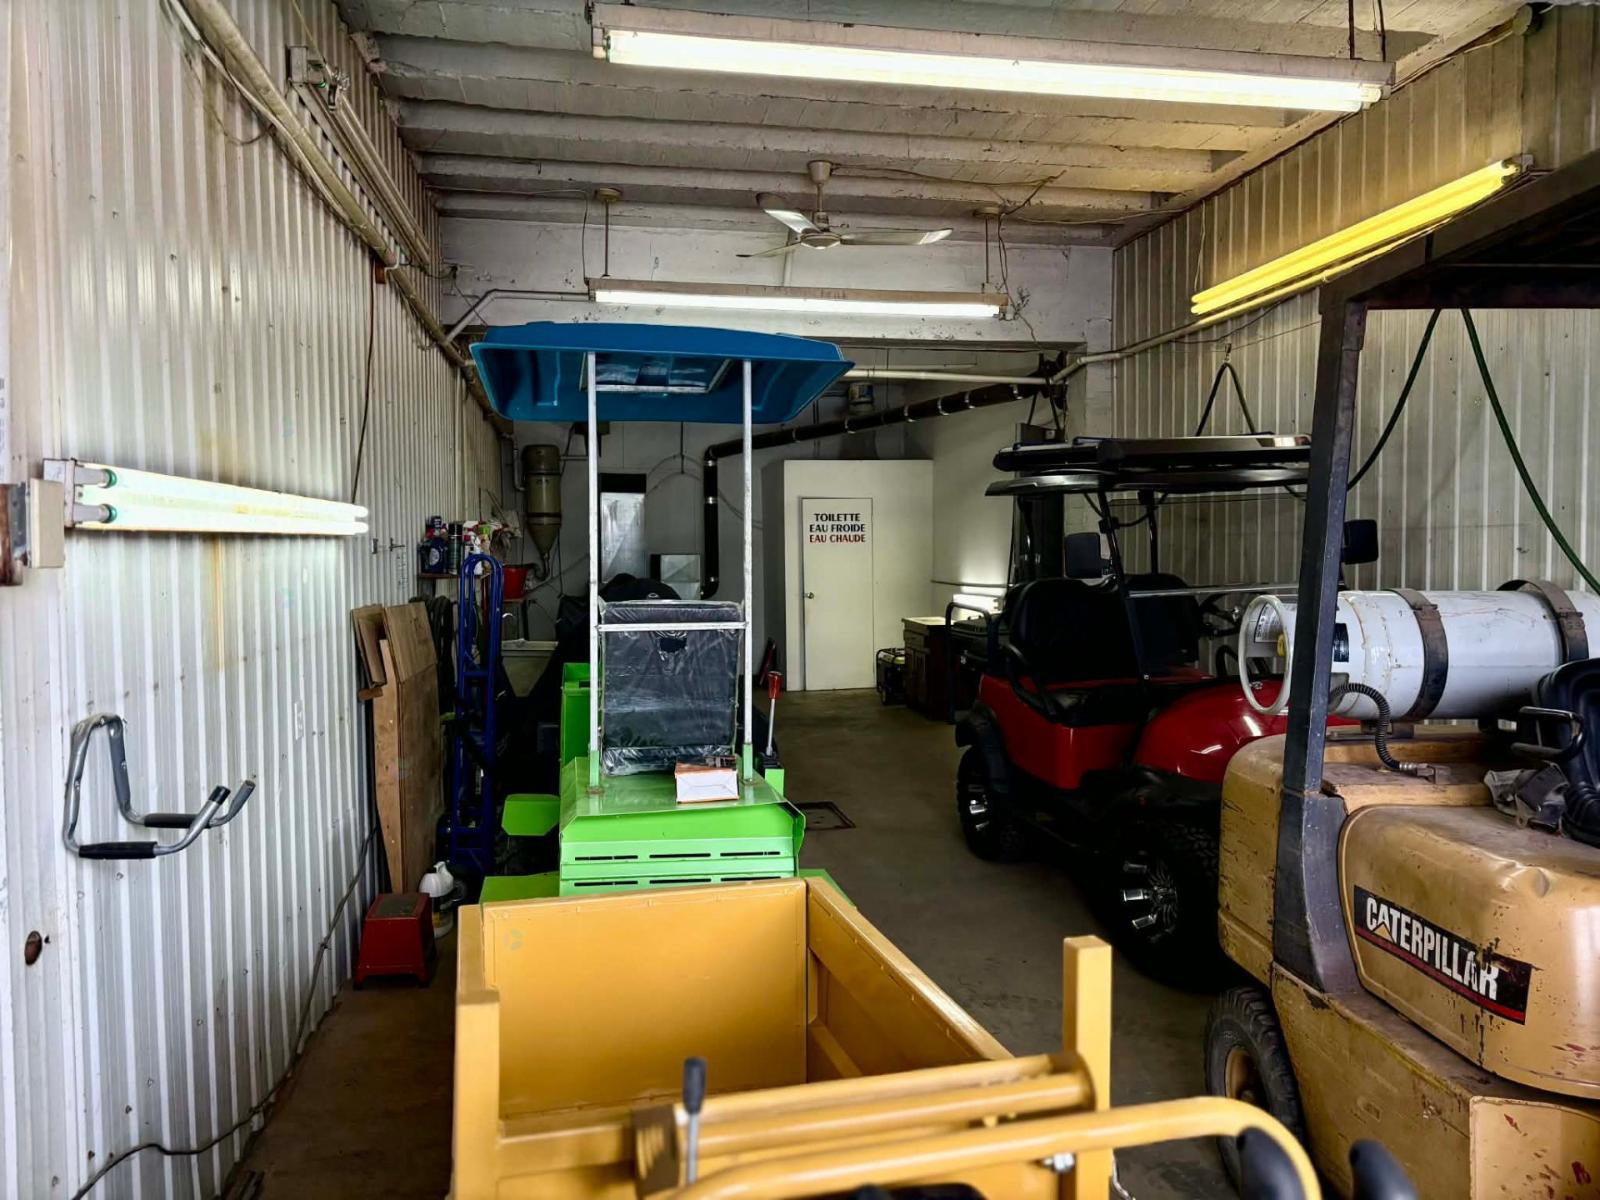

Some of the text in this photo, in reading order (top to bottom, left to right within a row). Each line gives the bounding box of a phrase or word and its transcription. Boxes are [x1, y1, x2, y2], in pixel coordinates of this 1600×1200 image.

[813, 513, 861, 522] TOILETTE
[809, 524, 866, 532] EAU FROIDE
[809, 534, 866, 543] EAU CHAUDE
[1366, 896, 1499, 1001] CATERPILLAR
